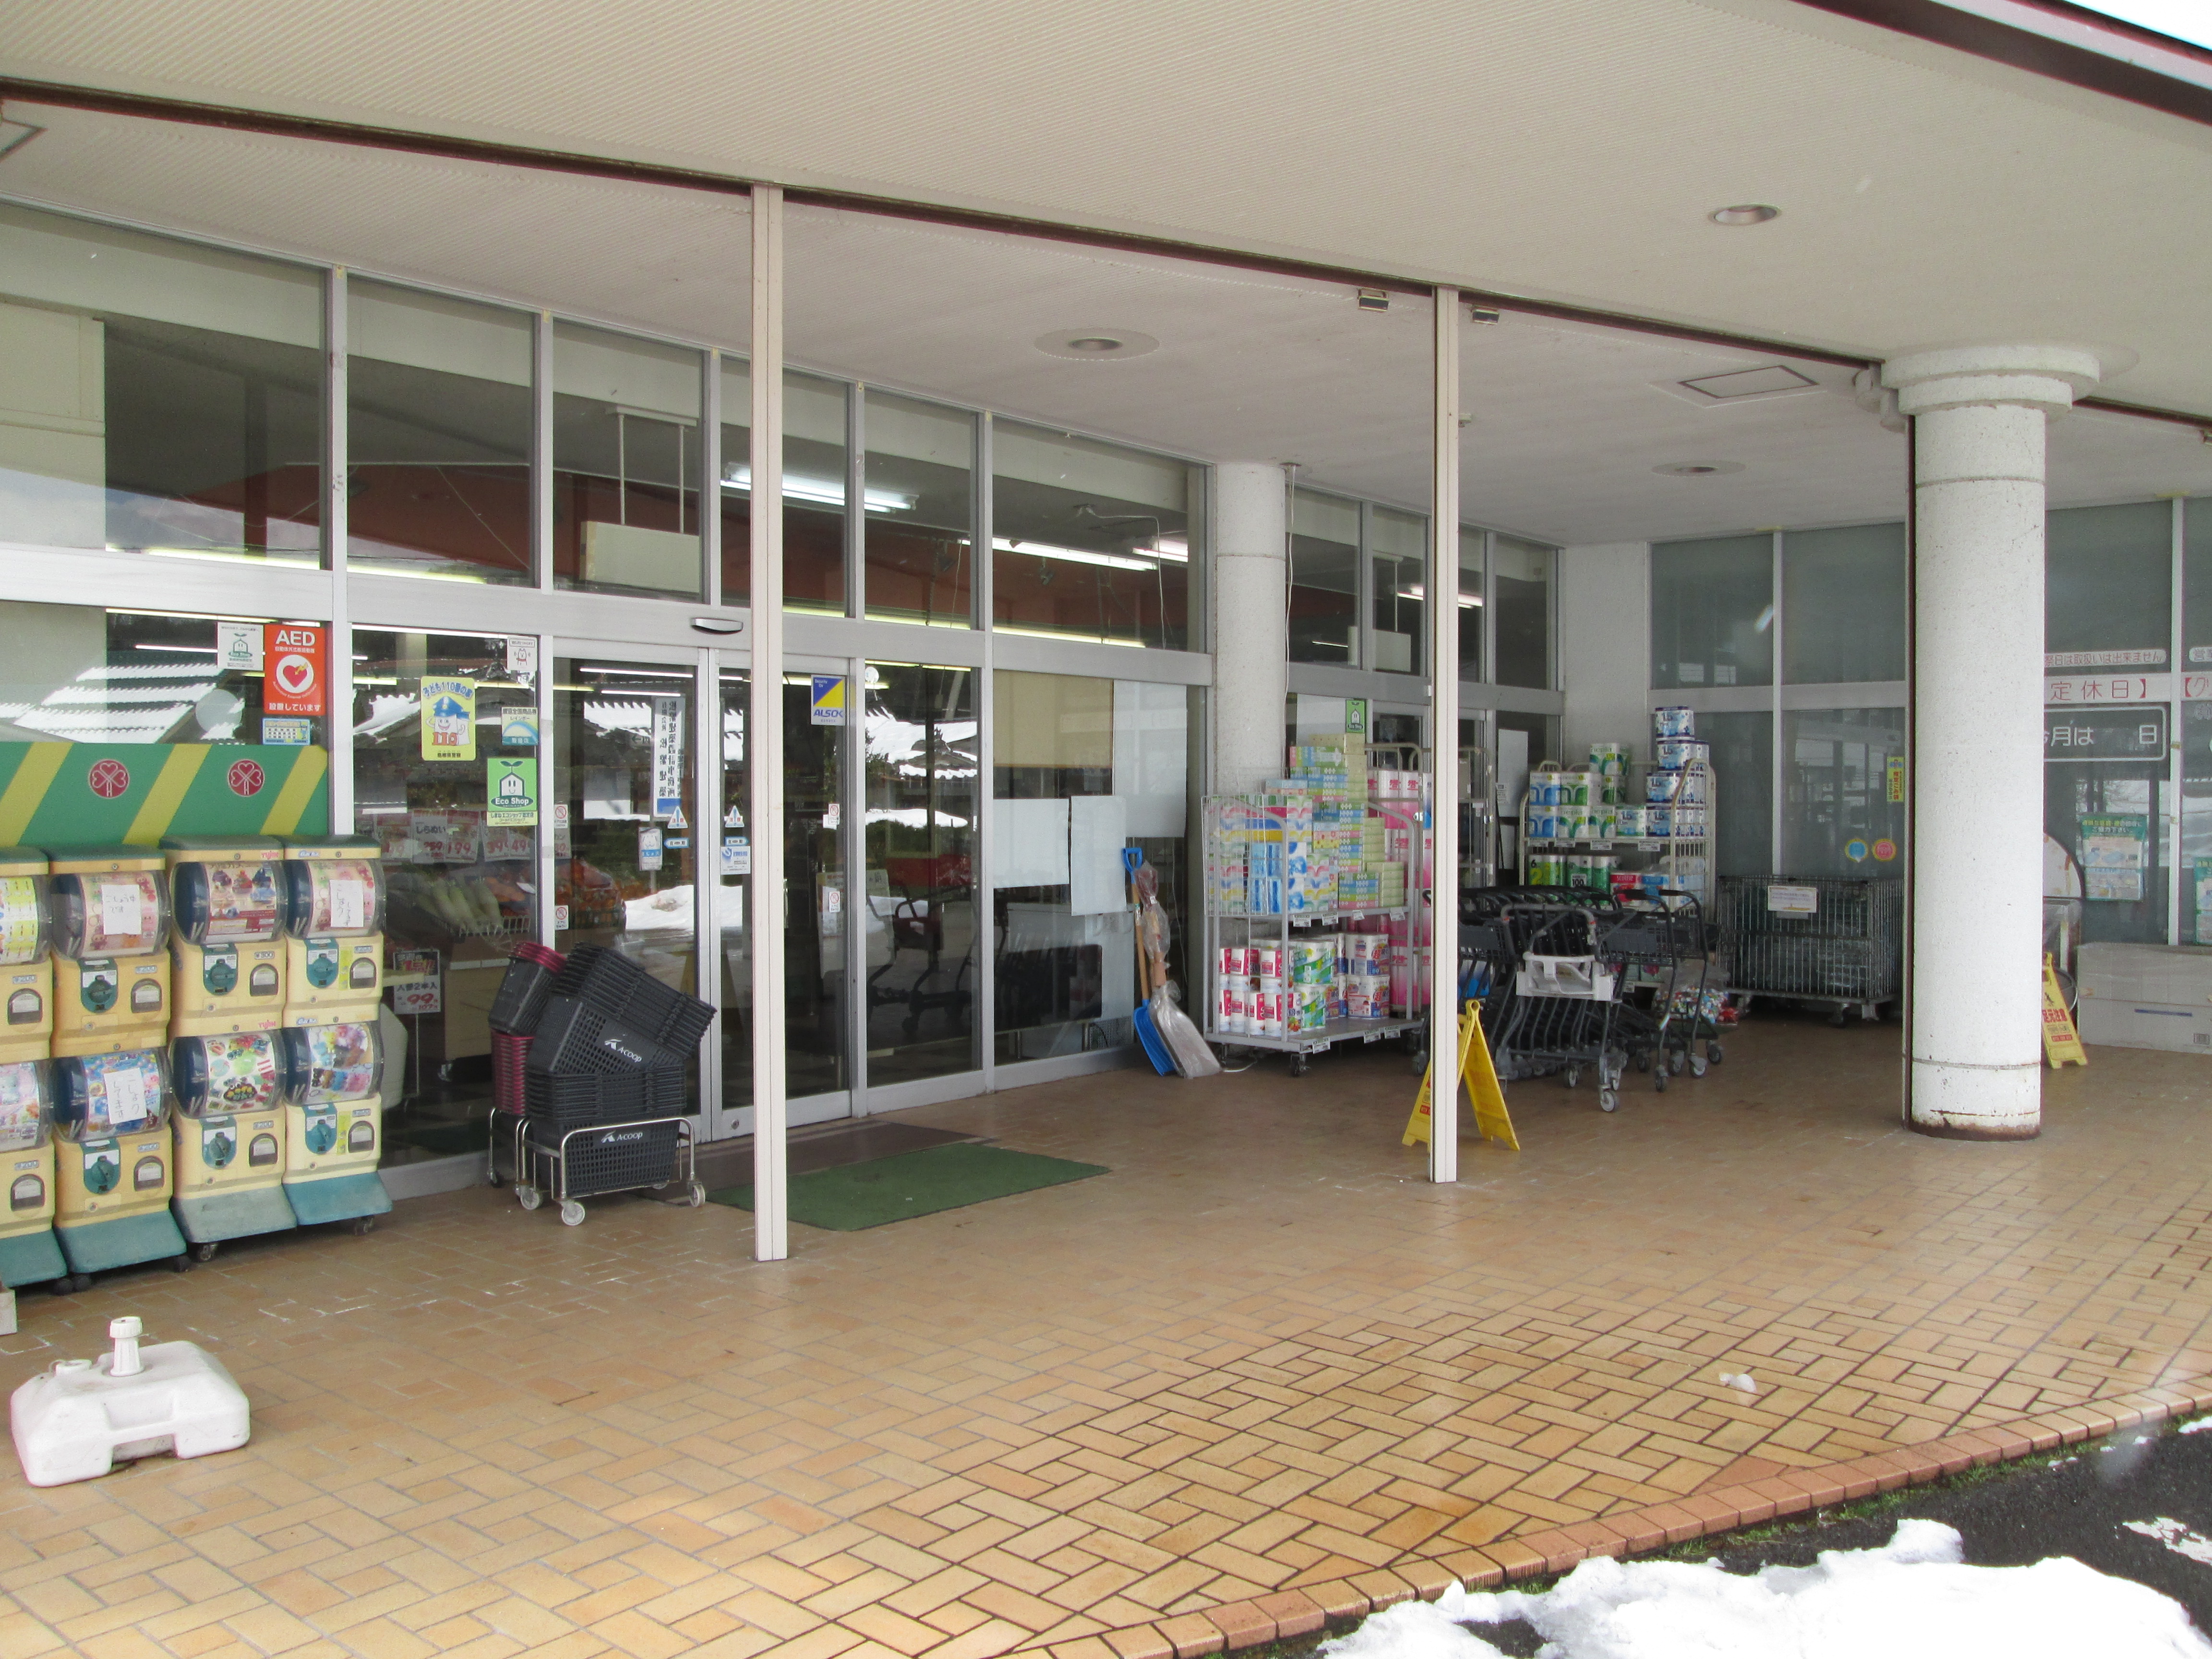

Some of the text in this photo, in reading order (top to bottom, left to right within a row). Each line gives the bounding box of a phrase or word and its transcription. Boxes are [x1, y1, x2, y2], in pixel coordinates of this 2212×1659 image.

[276, 630, 315, 646] AED
[422, 682, 473, 699] 子ども110番の家
[269, 702, 321, 712] 設置しています
[813, 709, 843, 718] ALSOK
[433, 732, 458, 745] 110
[2139, 725, 2157, 745] 日
